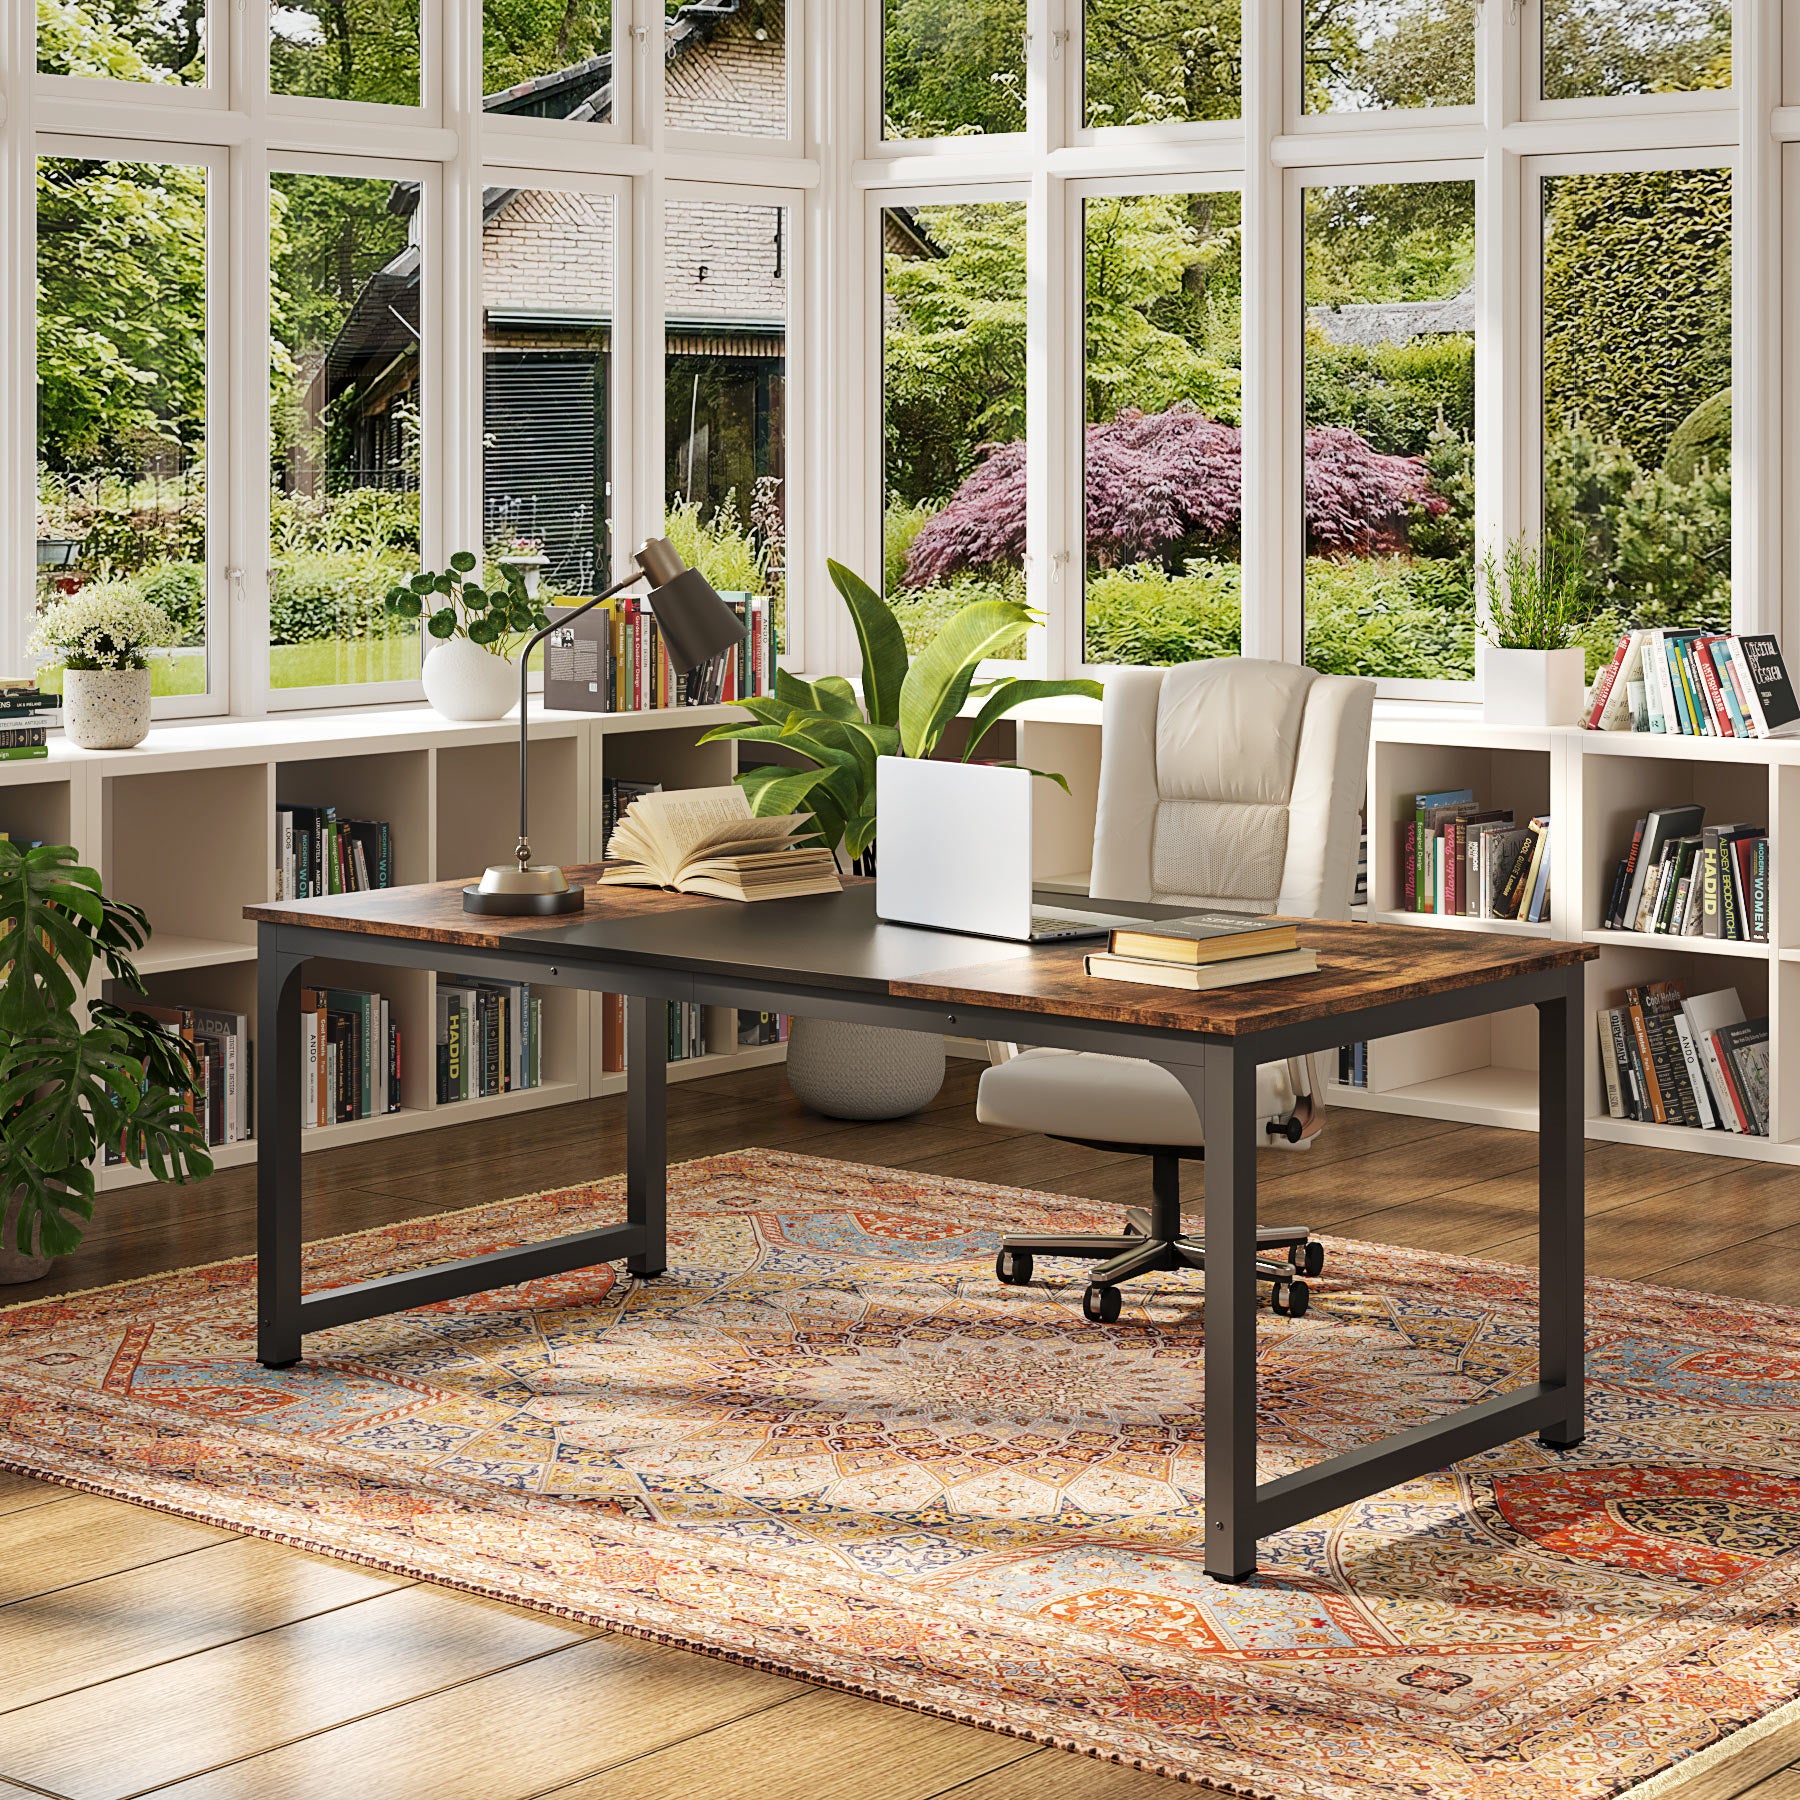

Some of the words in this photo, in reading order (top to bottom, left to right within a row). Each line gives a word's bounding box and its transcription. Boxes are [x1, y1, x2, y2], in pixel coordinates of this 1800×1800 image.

[1703, 663, 1724, 712] ANTIQUAIRES
[1406, 824, 1415, 852] Parr
[1446, 826, 1455, 854] Parr
[1520, 838, 1532, 854] COOL
[1626, 832, 1642, 873] BAUHAUS
[1512, 855, 1524, 874] GUIDE
[1719, 837, 1730, 873] ALEXEY
[1405, 855, 1415, 898] Martin
[1445, 856, 1455, 900] Martin
[1704, 848, 1716, 915] HADID
[1755, 879, 1764, 932] WOMEN
[1612, 1015, 1623, 1037] Aalto
[450, 1015, 459, 1079] HADID
[1617, 1038, 1627, 1062] Alvar
[1637, 1033, 1647, 1054] Hotels
[1682, 1036, 1694, 1064] ANDO
